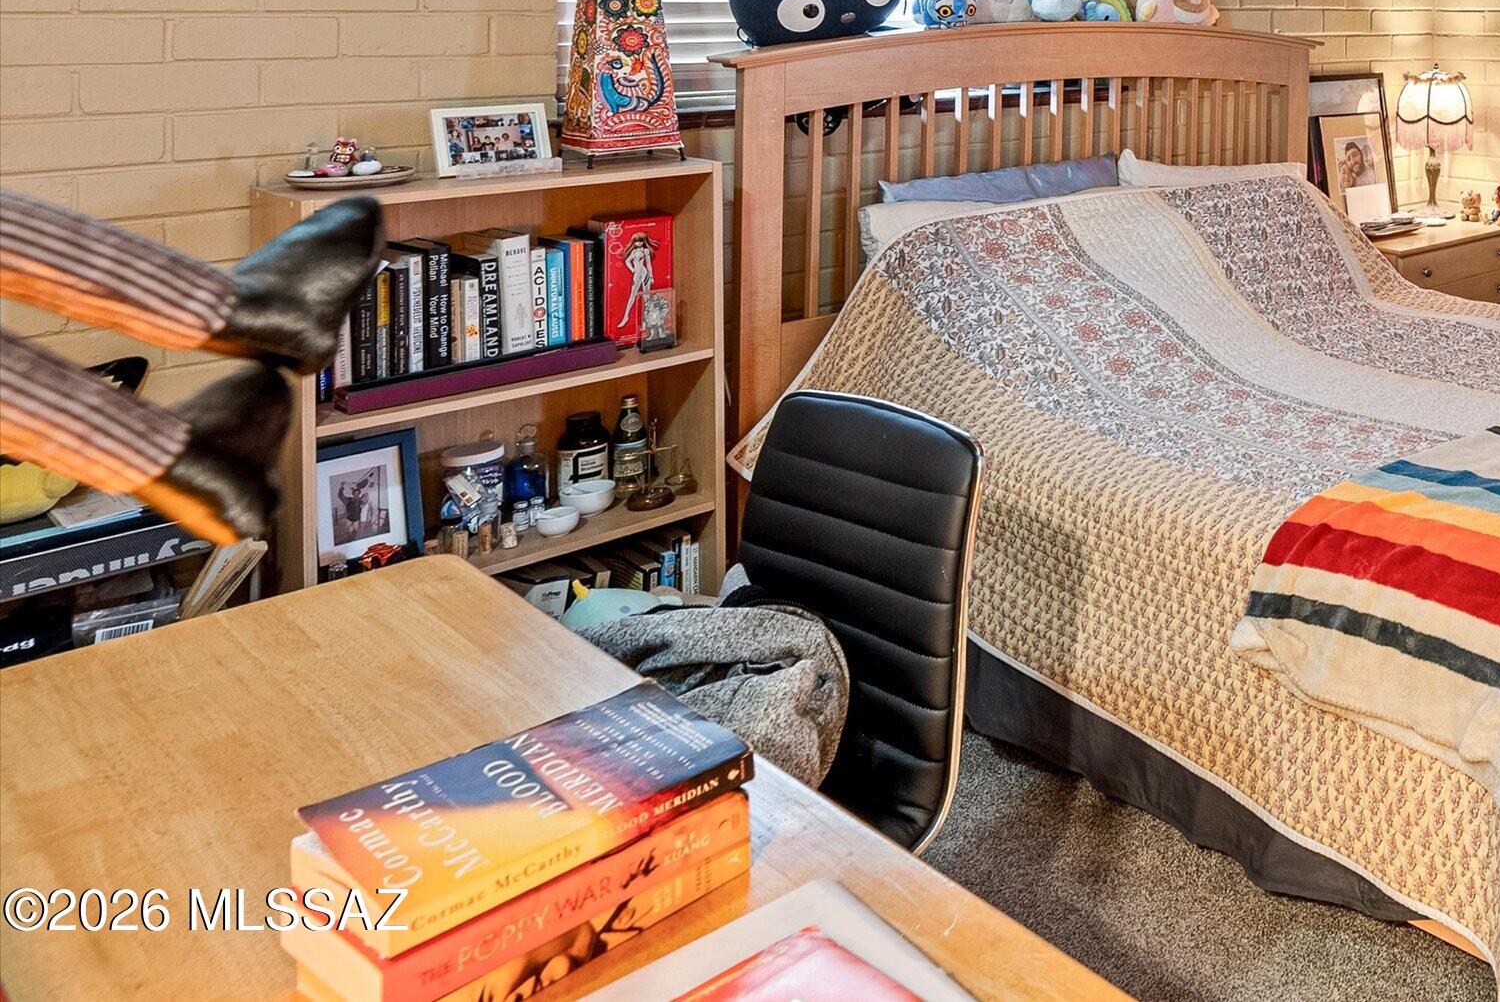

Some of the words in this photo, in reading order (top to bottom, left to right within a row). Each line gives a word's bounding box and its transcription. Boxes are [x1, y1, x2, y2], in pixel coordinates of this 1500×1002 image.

[429, 255, 438, 280] Pollan
[440, 253, 448, 287] Michael
[429, 295, 438, 314] Your
[440, 294, 448, 313] How
[550, 267, 558, 311] UNNATURAL
[429, 317, 439, 338] Mind
[440, 315, 448, 323] to
[485, 262, 498, 358] DREAMLAND
[413, 326, 421, 355] MEDICINE
[439, 325, 448, 357] Change
[482, 759, 568, 819] BLOOD
[505, 733, 626, 819] MERIDIAN
[653, 777, 720, 817] MERIDIAN
[380, 777, 491, 879] McCarthy
[339, 807, 424, 889] Cormac
[663, 835, 711, 866] KUANG
[410, 890, 487, 931] Cormac
[495, 844, 583, 893] McCarthy
[457, 905, 551, 974] POPPY
[553, 875, 614, 919] WAR
